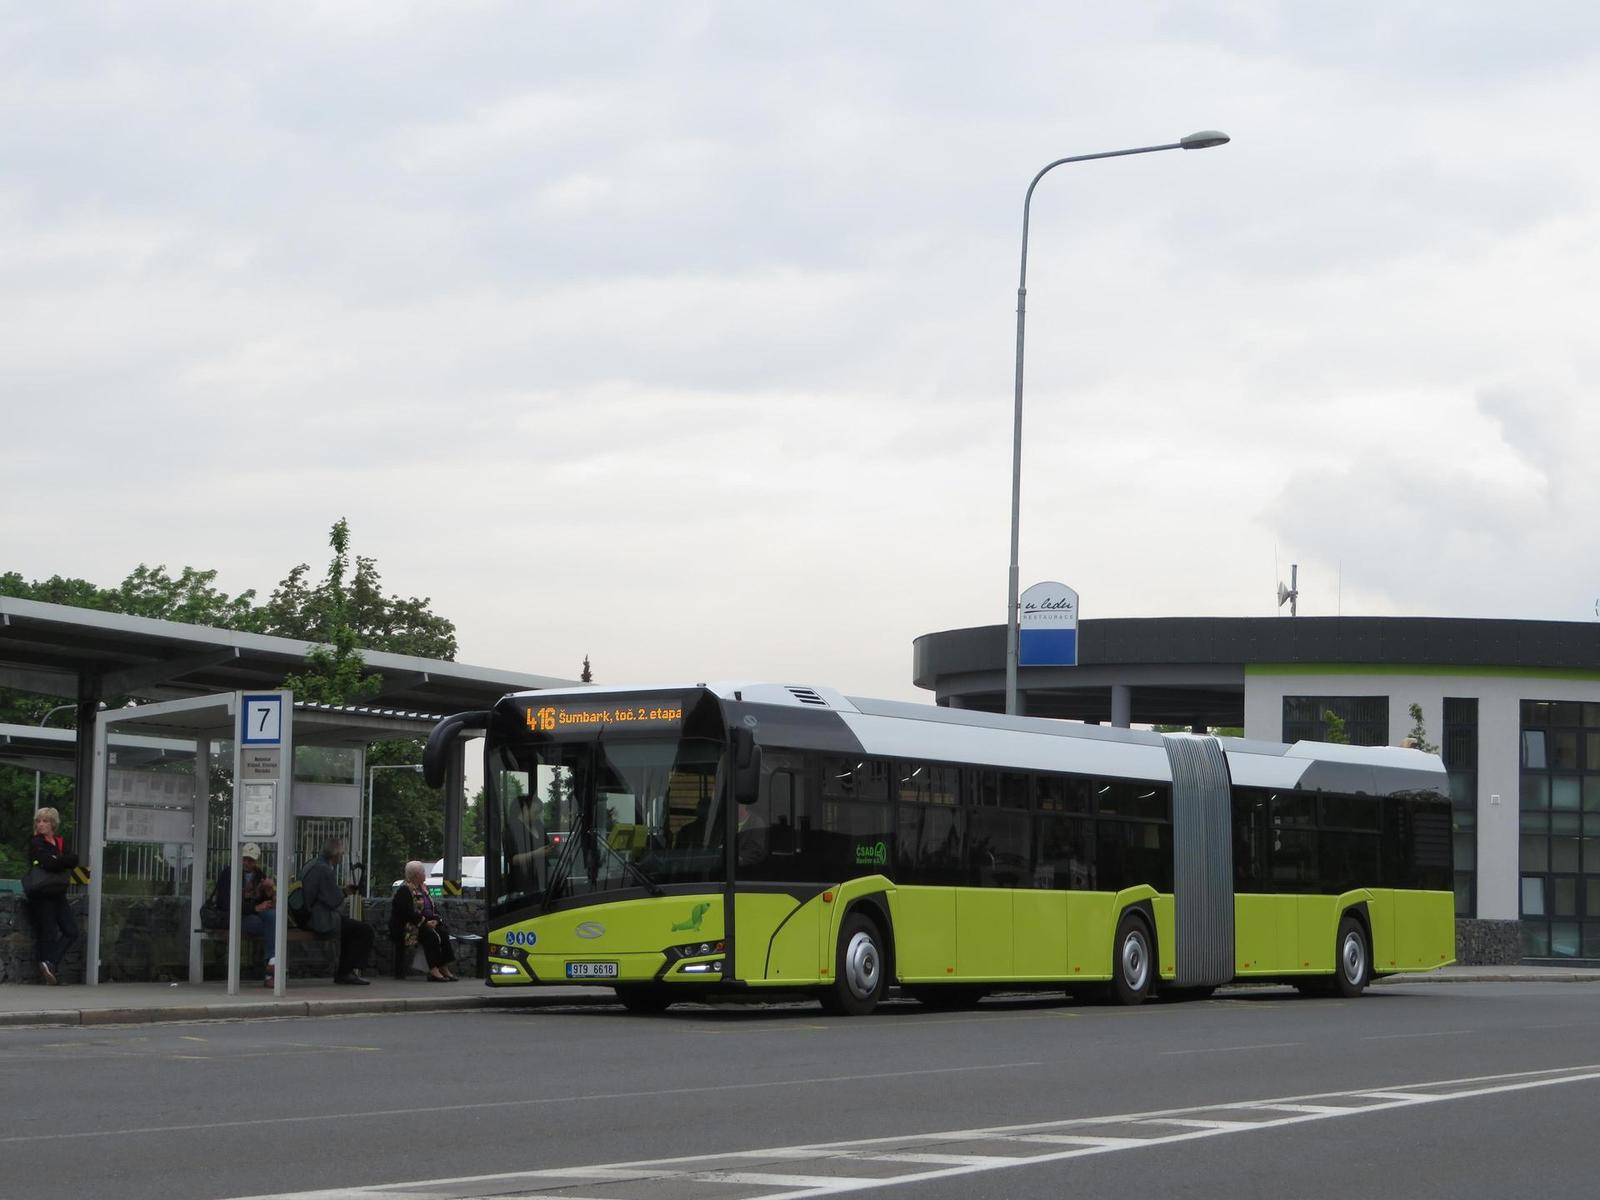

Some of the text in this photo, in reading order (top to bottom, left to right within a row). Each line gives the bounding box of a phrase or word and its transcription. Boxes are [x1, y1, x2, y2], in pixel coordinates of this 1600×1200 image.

[257, 708, 271, 732] 7
[526, 705, 682, 731] 416 Šumbark, toč. 2. etapa
[856, 843, 874, 857] ČSAD
[573, 964, 614, 974] 9T9 6618
